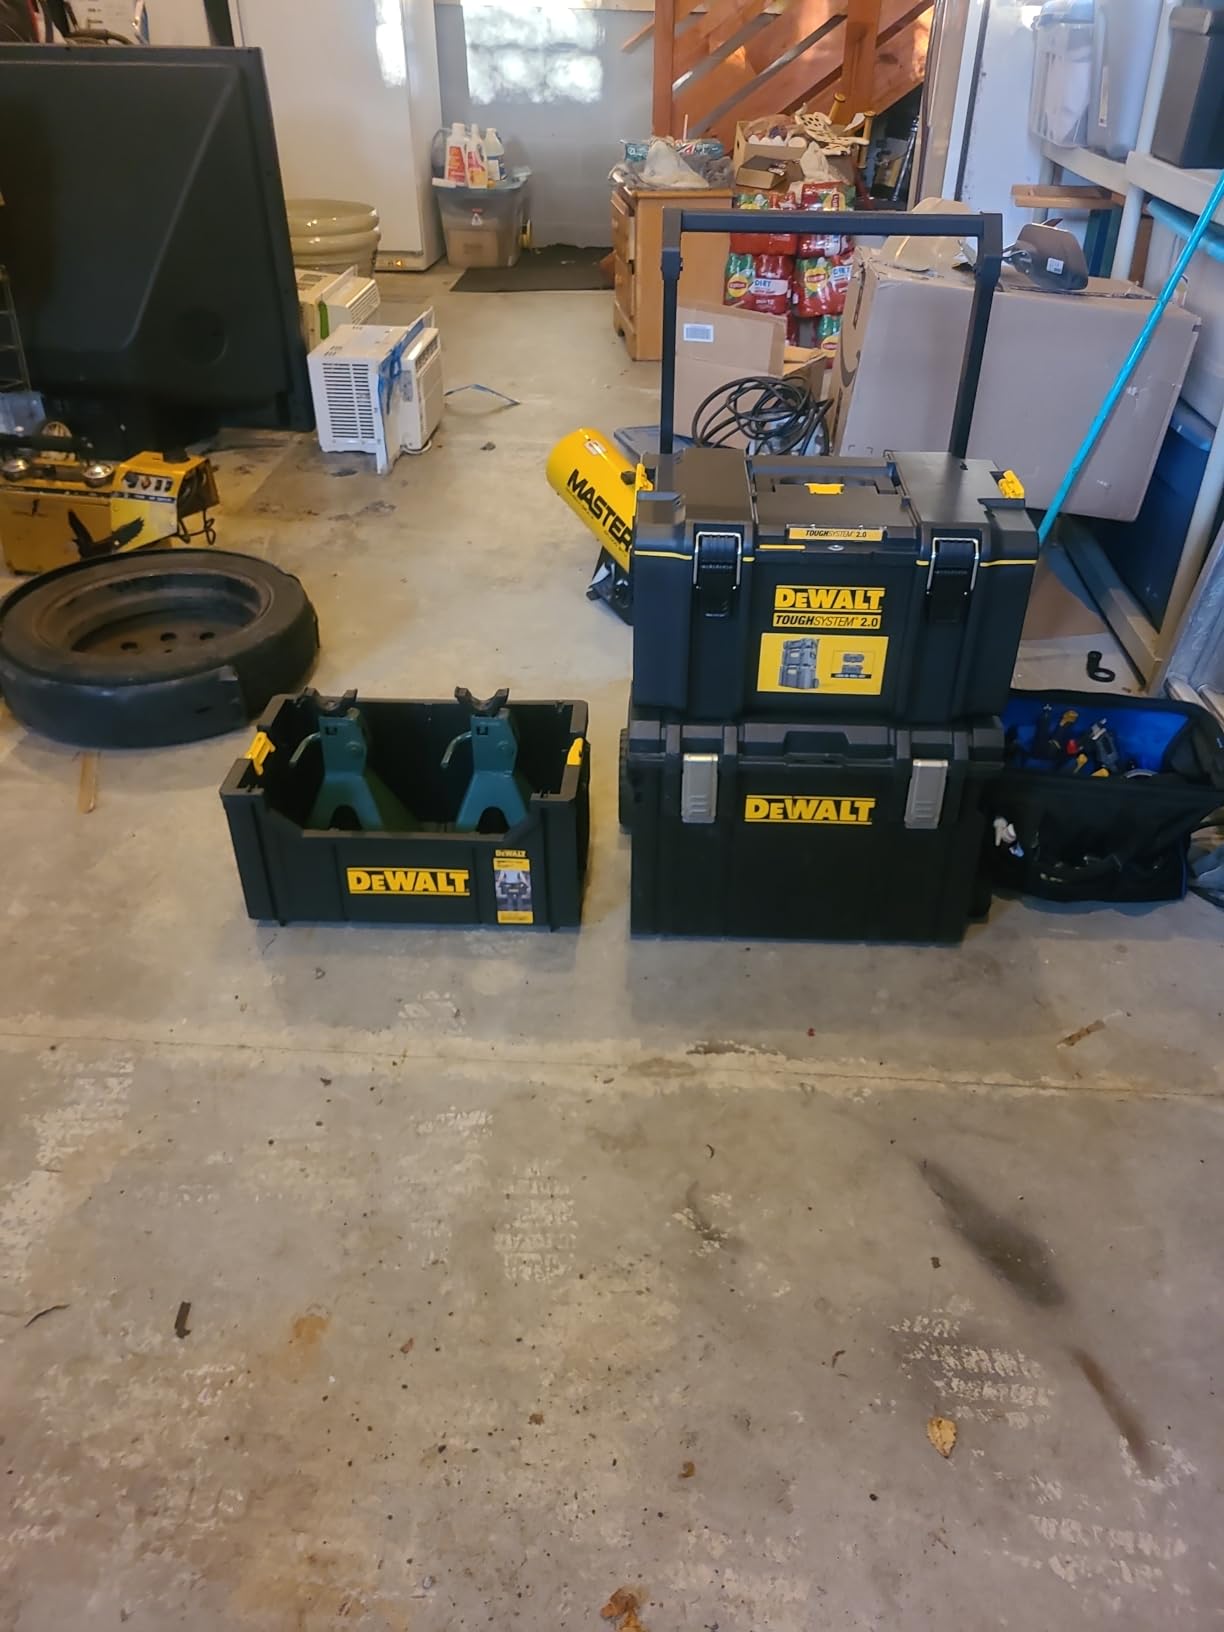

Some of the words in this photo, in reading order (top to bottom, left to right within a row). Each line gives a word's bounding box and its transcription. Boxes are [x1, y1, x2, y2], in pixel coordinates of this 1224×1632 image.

[567, 468, 633, 552] MASTER
[805, 530, 853, 538] TOUGHSYSTEM
[776, 615, 856, 627] TOUGHSYSTEM
[861, 617, 879, 627] 2.0
